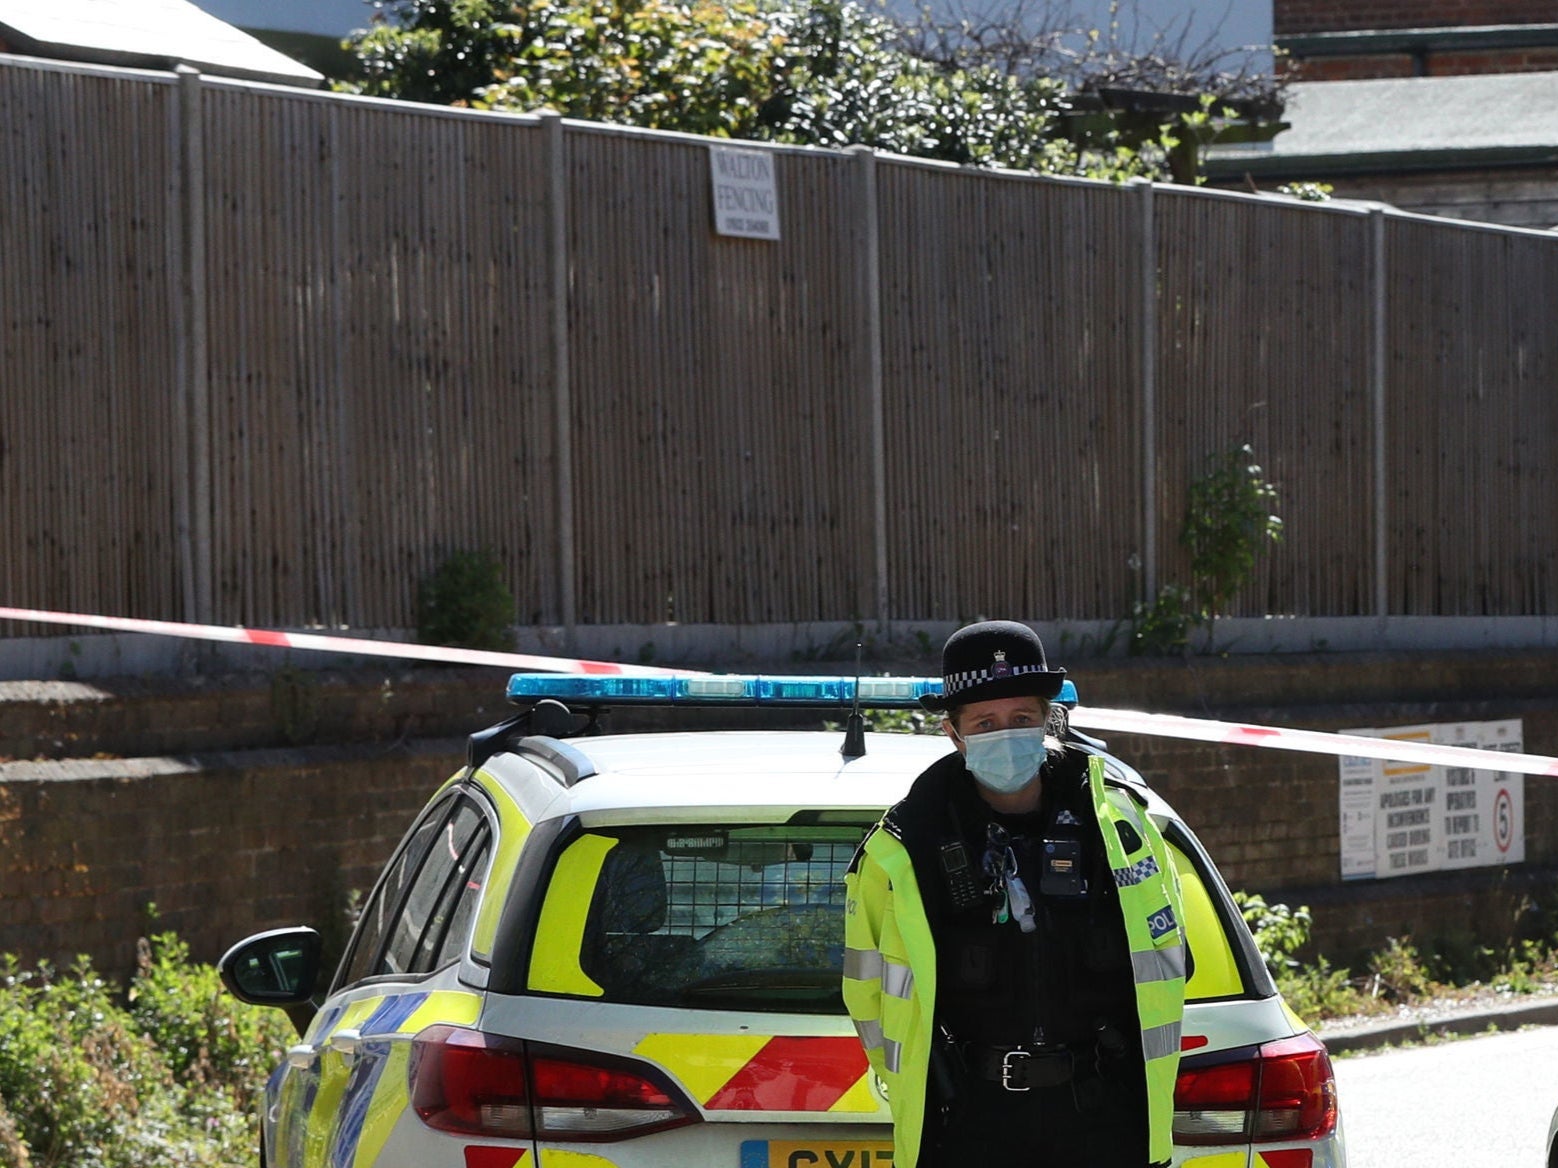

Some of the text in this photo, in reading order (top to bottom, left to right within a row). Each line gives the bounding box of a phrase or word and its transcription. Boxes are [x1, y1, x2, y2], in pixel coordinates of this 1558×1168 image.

[715, 151, 770, 181] WALTON
[717, 184, 774, 215] FENCING
[1499, 802, 1508, 840] 5
